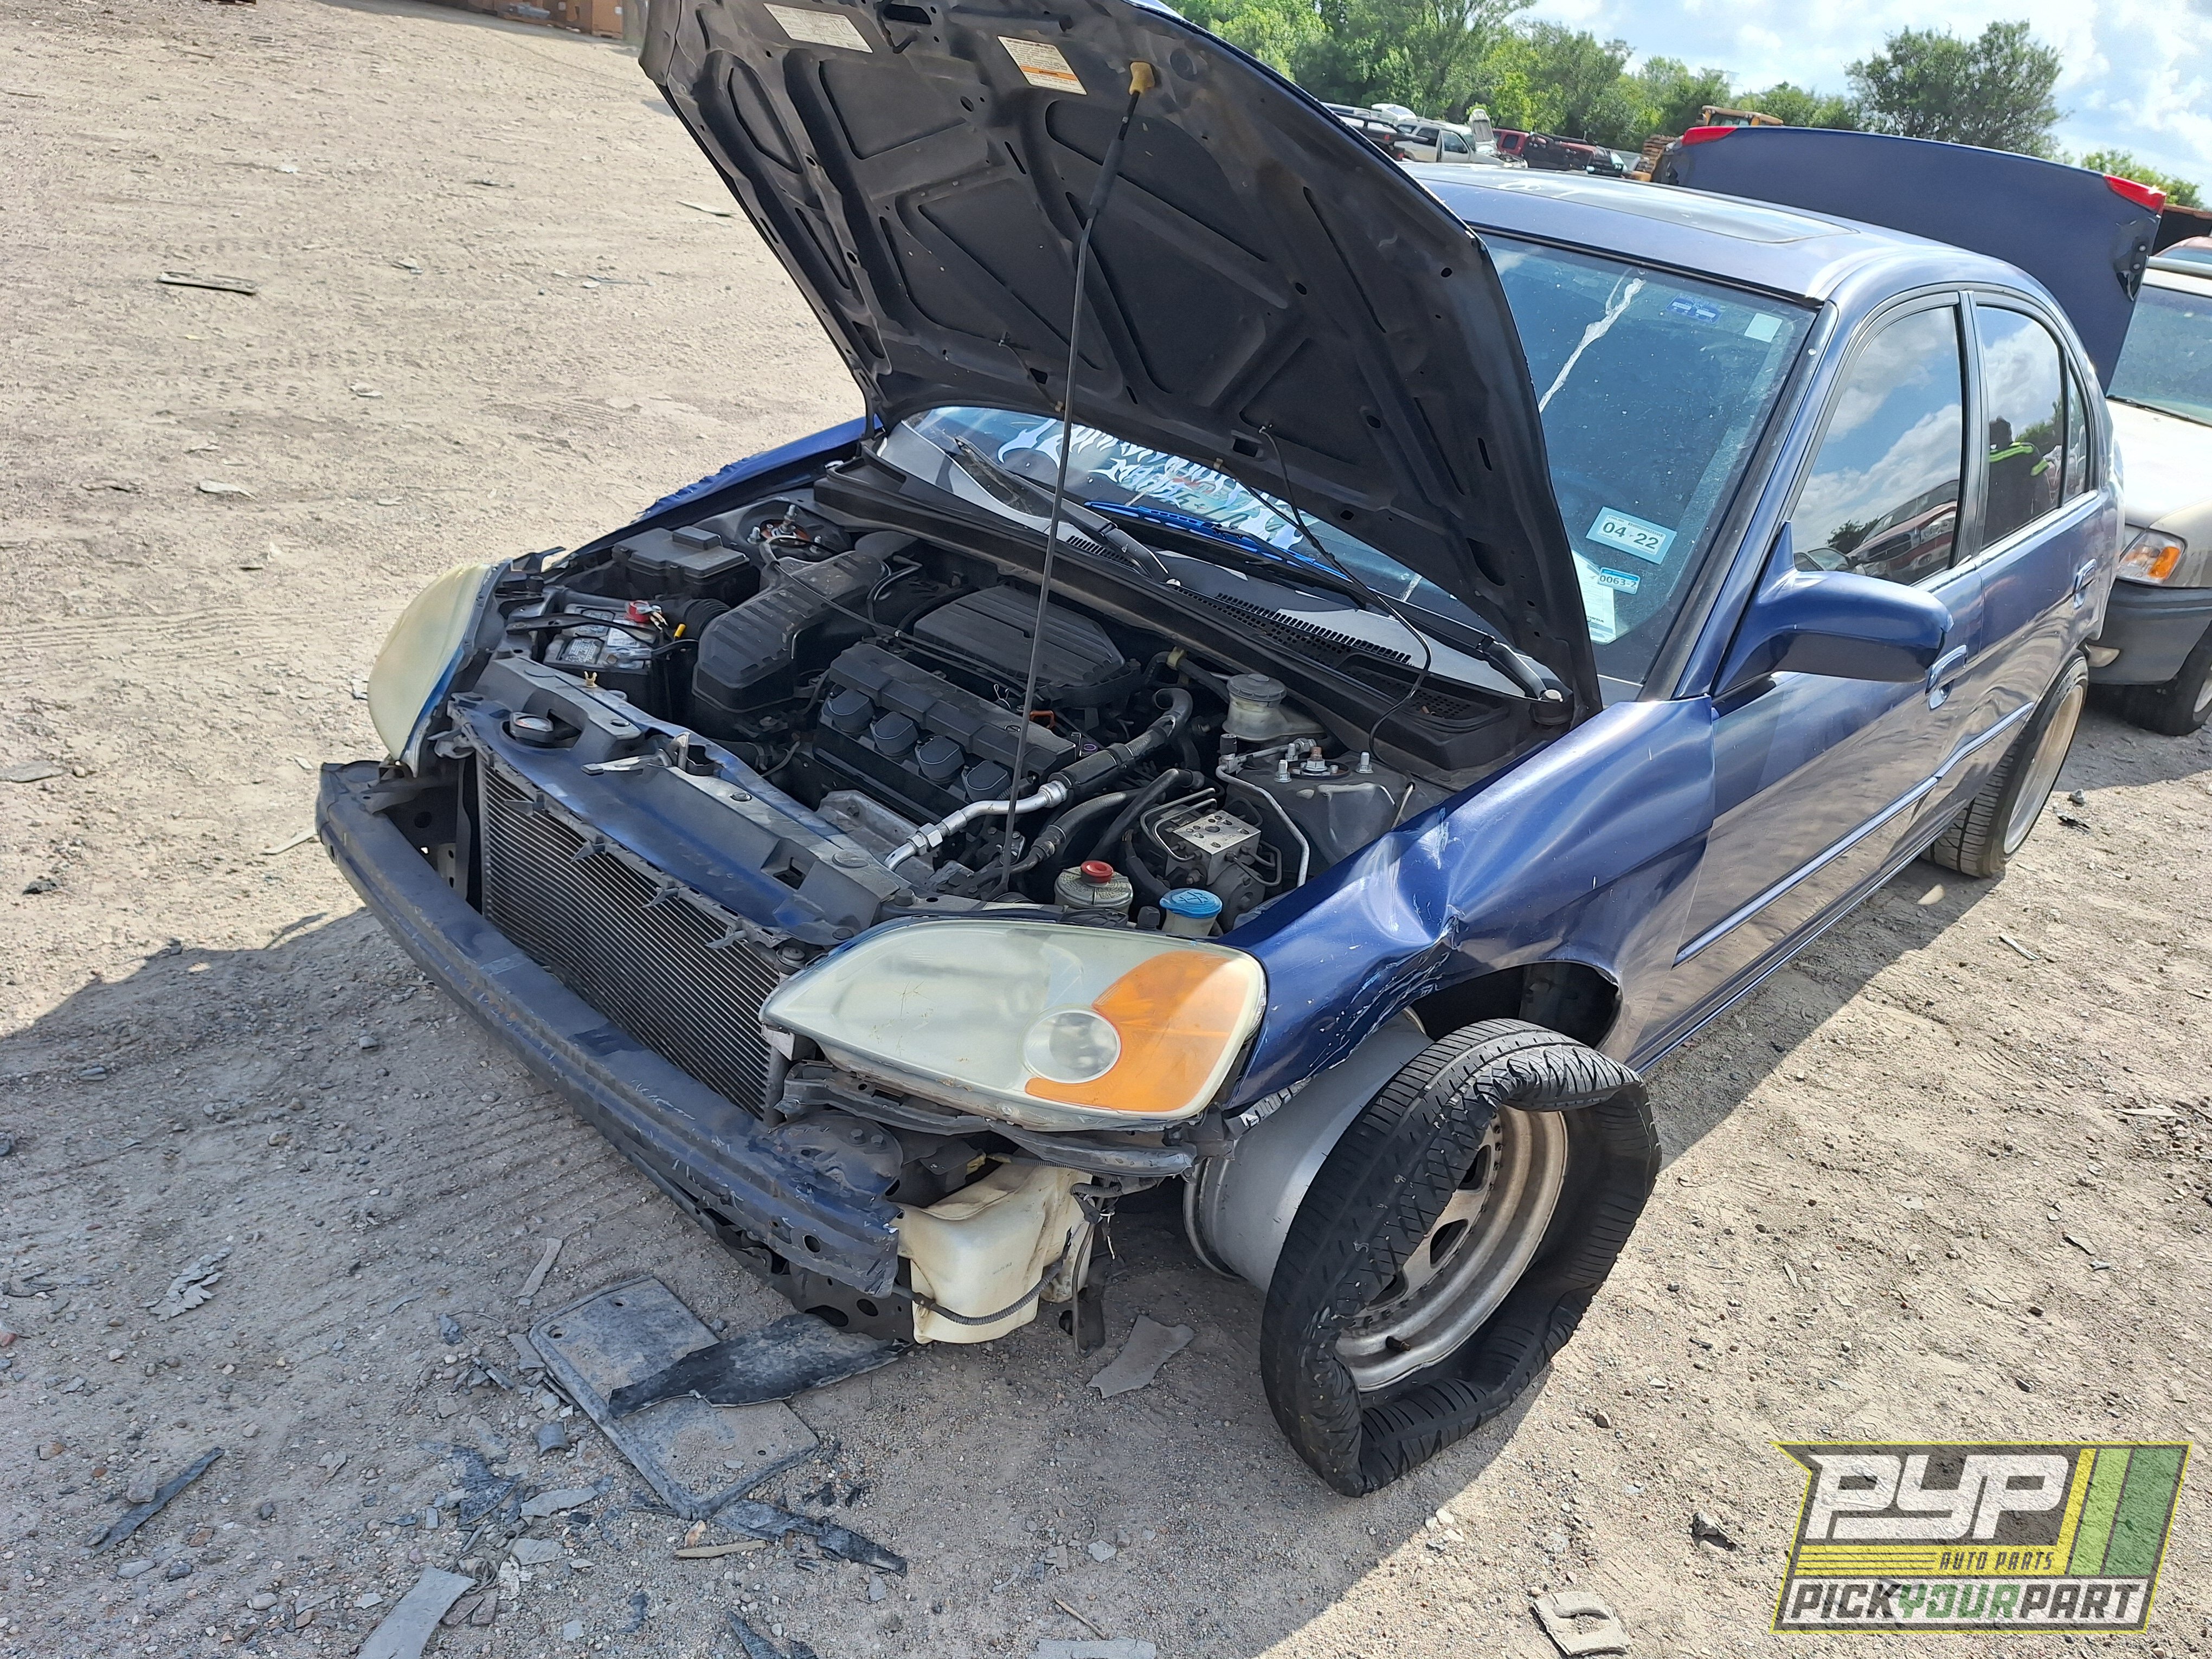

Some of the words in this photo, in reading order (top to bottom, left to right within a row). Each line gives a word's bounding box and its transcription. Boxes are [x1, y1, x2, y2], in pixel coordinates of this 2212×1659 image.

[1603, 522, 1626, 538] 04
[1634, 533, 1658, 549] 22
[1599, 575, 1637, 587] 0063-2
